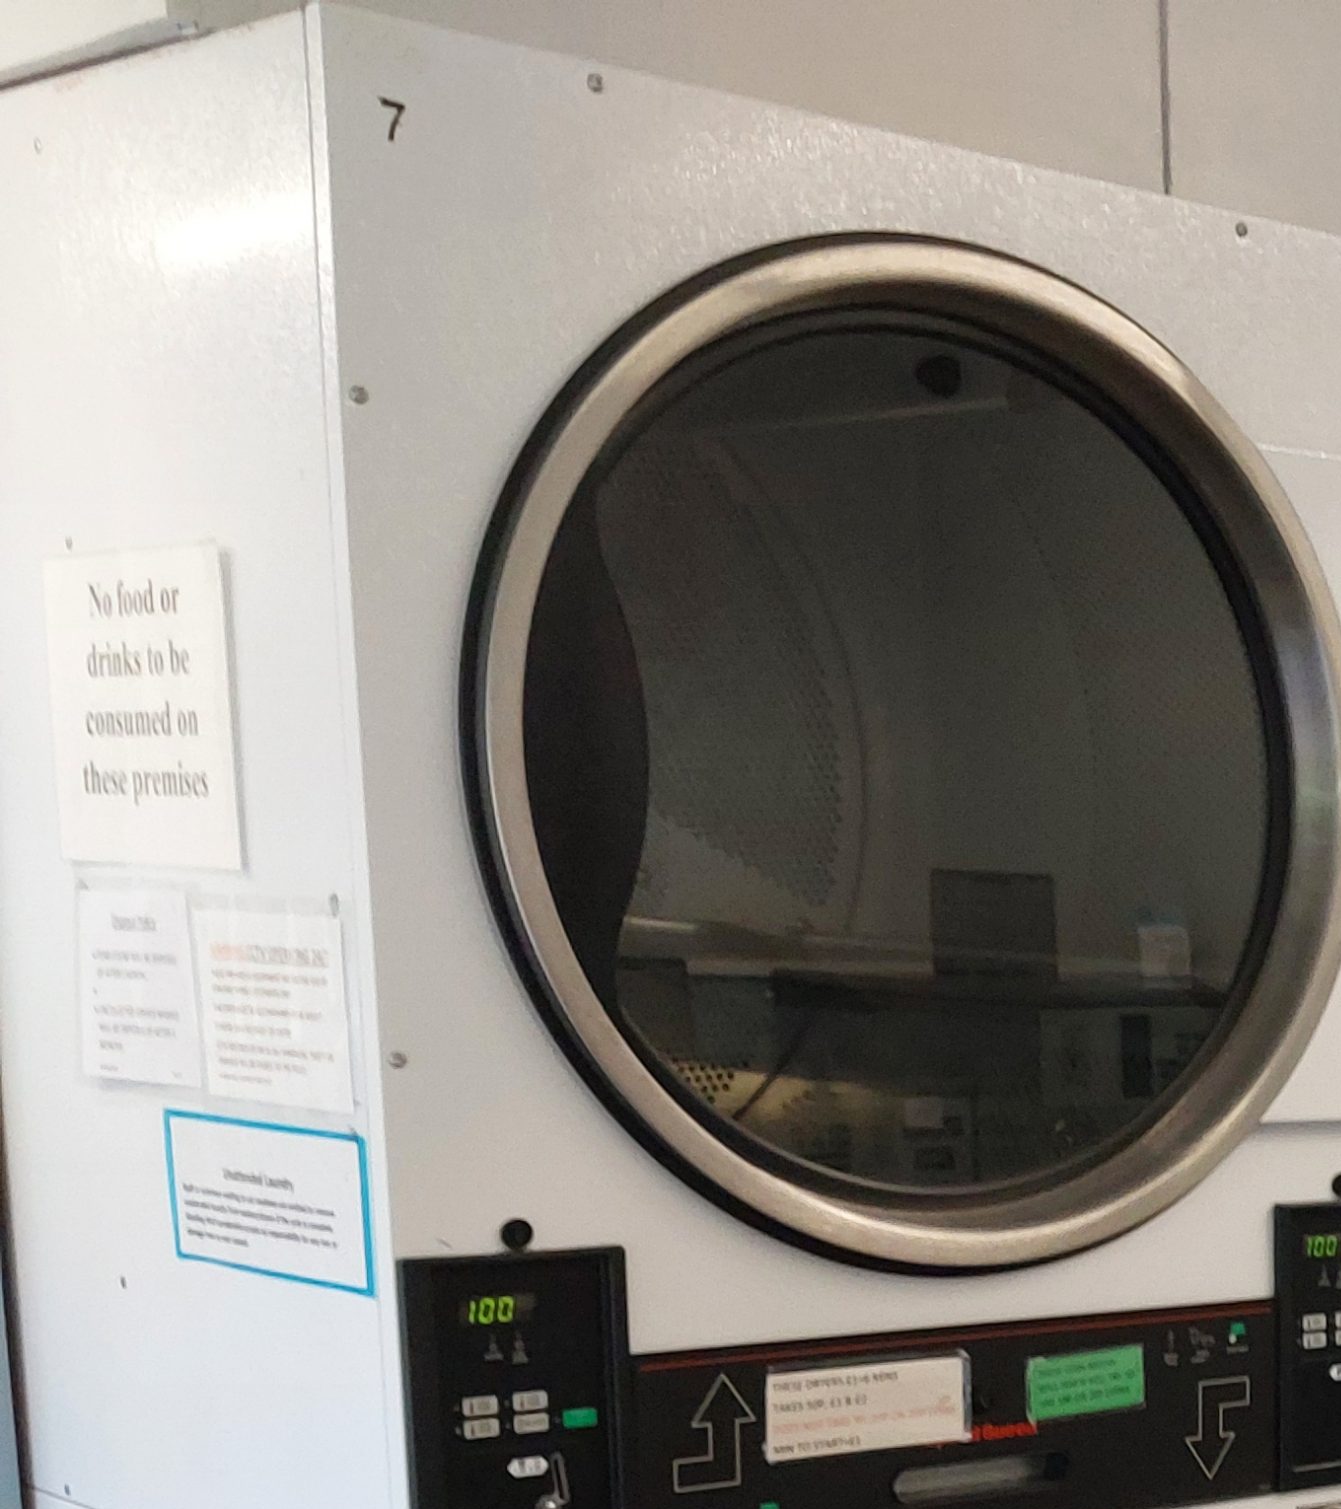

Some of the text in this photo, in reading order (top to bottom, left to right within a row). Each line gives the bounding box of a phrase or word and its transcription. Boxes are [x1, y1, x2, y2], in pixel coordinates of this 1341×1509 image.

[376, 96, 406, 141] 7
[89, 579, 179, 618] No food or
[87, 639, 190, 678] drinks to be
[85, 700, 199, 738] consumed on
[83, 760, 209, 806] these premises
[1306, 1234, 1338, 1258] 100
[469, 1295, 515, 1325] 100
